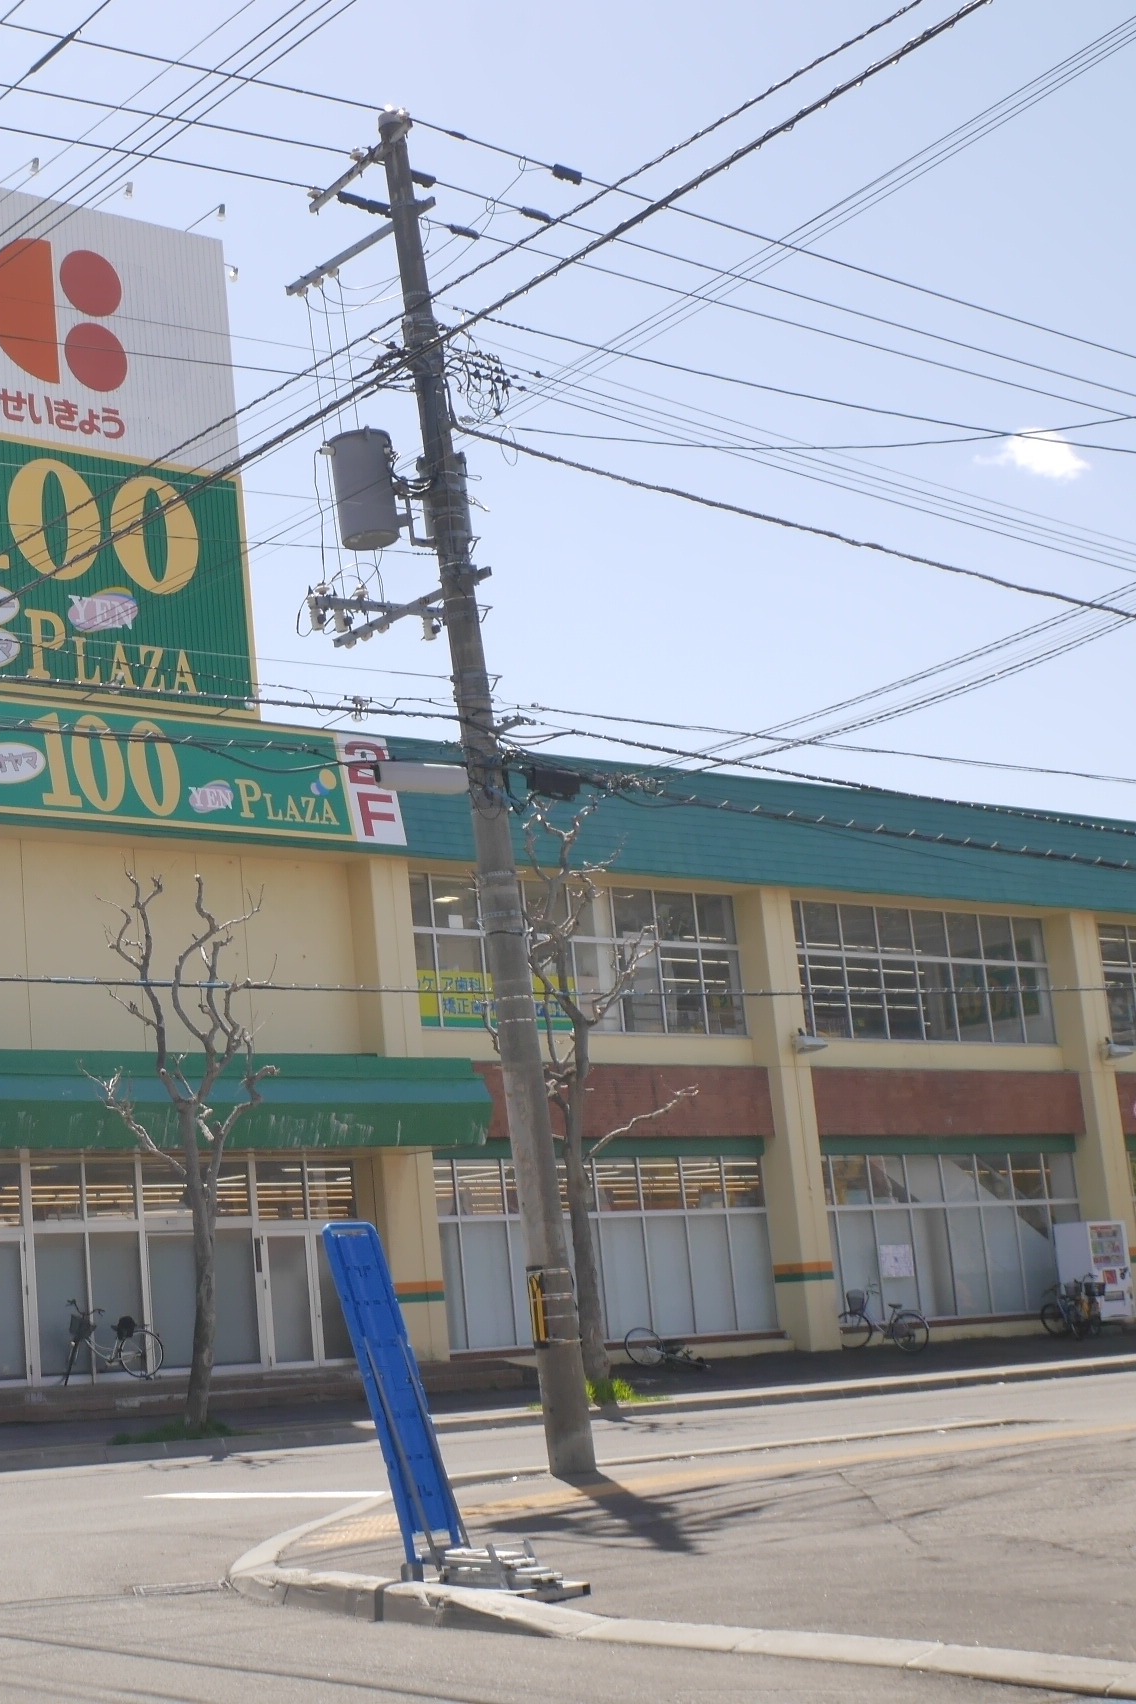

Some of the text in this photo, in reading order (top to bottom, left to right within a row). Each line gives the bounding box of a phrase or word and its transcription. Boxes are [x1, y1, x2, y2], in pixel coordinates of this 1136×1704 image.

[68, 594, 135, 631] YEN
[25, 608, 200, 695] PLAZA
[30, 712, 181, 817] 100
[189, 778, 340, 826] YEN PLAZA
[417, 975, 483, 992] ケア歯科
